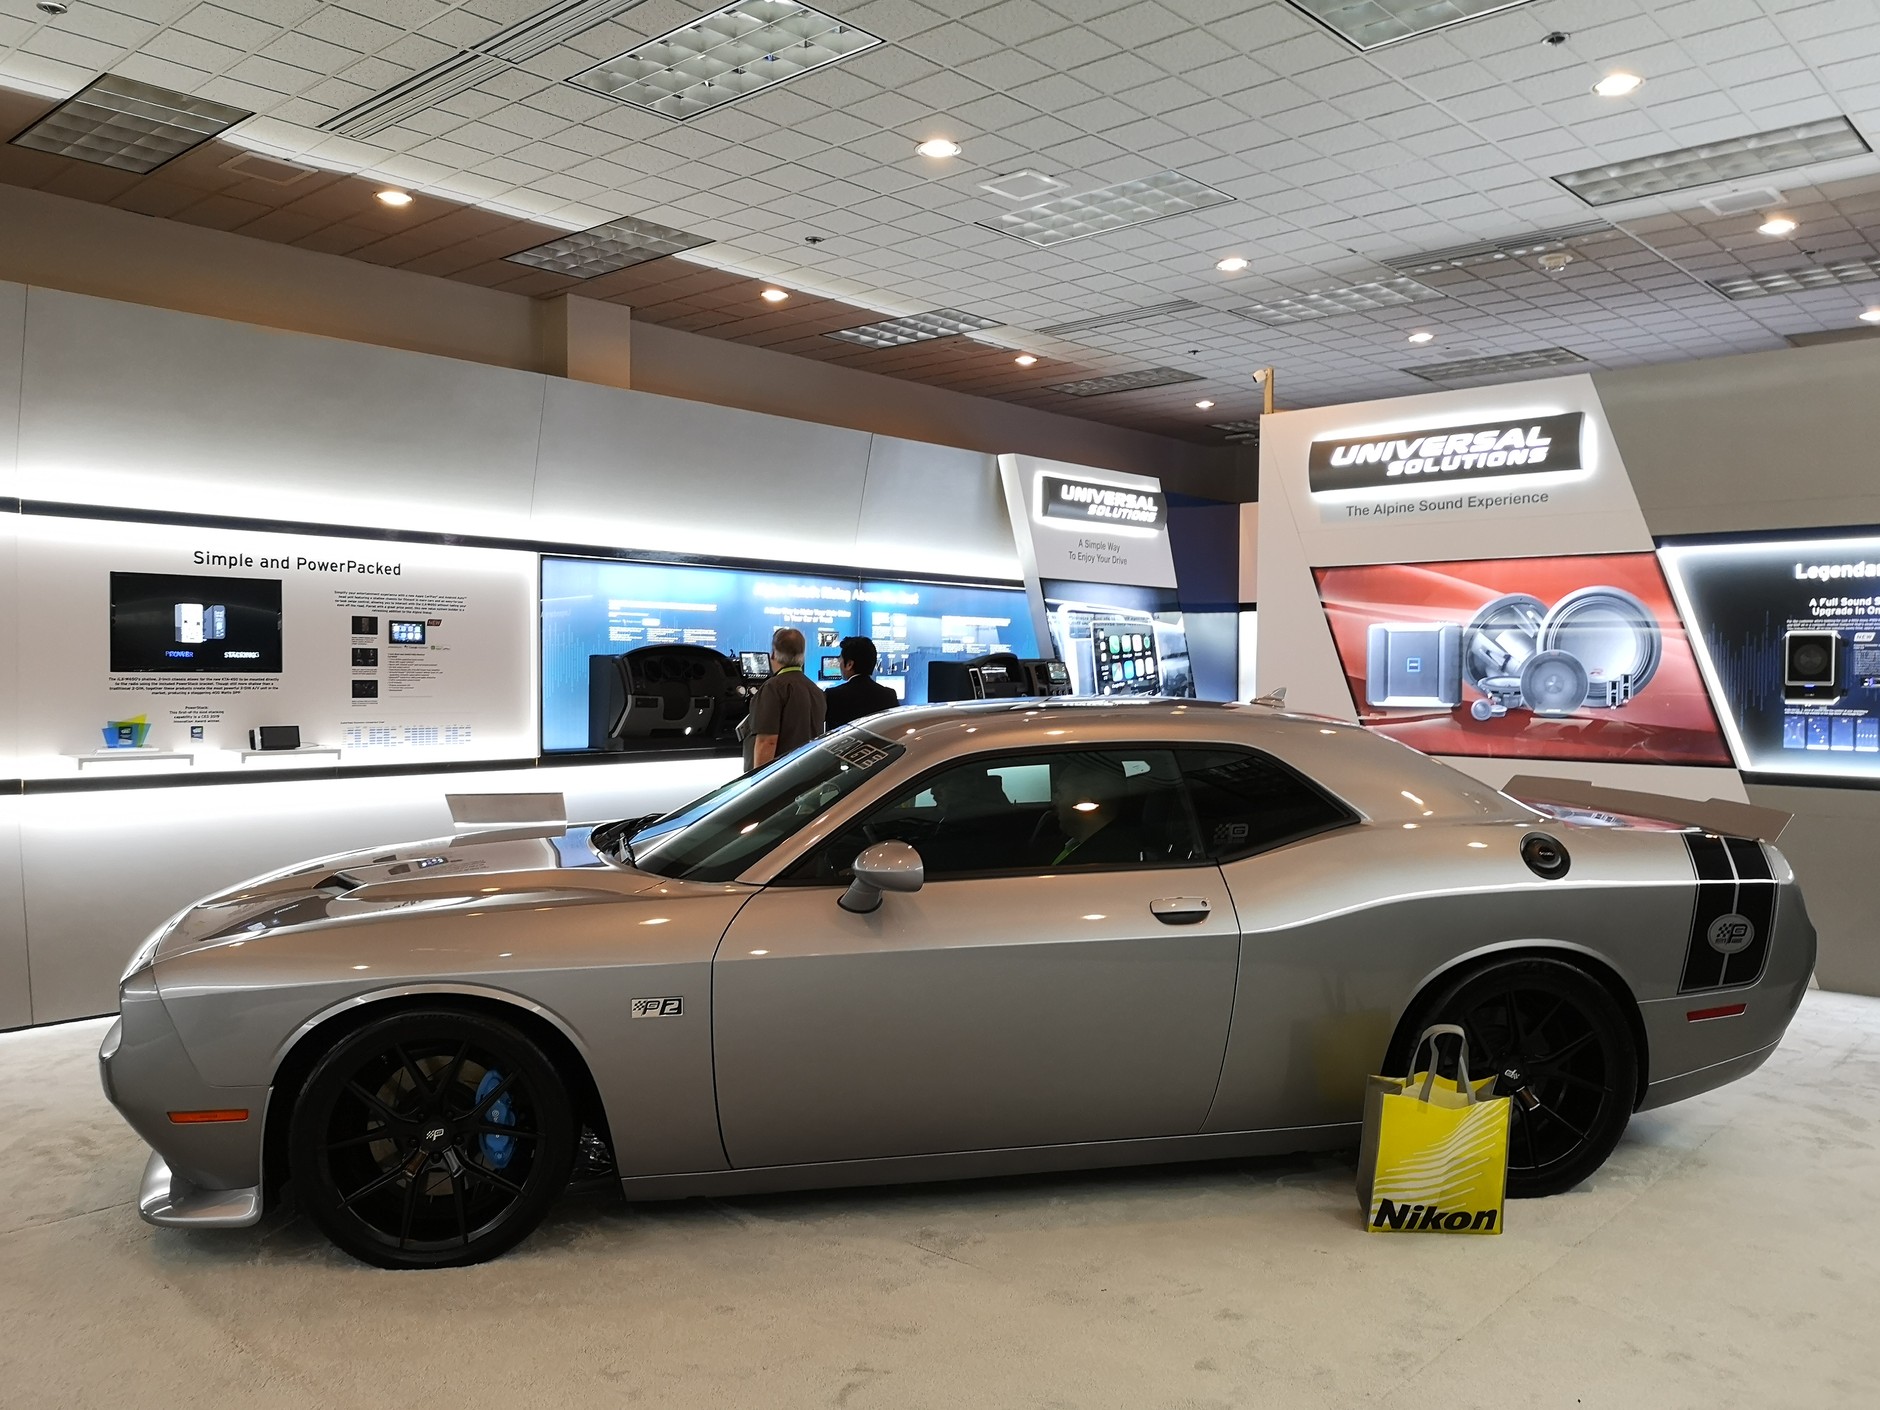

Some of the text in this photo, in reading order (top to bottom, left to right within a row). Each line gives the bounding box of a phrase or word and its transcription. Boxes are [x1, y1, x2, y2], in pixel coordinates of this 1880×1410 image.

[1330, 426, 1552, 467] UNIVERSAL
[1386, 447, 1549, 477] SOLUTIONS
[1061, 484, 1158, 512] UNIVERSAL
[1346, 493, 1549, 517] The Alpine Sound Experience
[1087, 504, 1157, 522] SOLUTIONS
[1068, 551, 1128, 565] To Enjoy Your Drive
[1078, 539, 1120, 553] A Simple Way
[193, 550, 401, 576] Simple and PowerPacked
[1808, 597, 1817, 607] A
[1819, 597, 1839, 607] Full
[1840, 596, 1872, 607] Sound
[1811, 606, 1854, 617] Upgrade
[1855, 606, 1865, 616] In
[1372, 1198, 1498, 1231] Nikon
